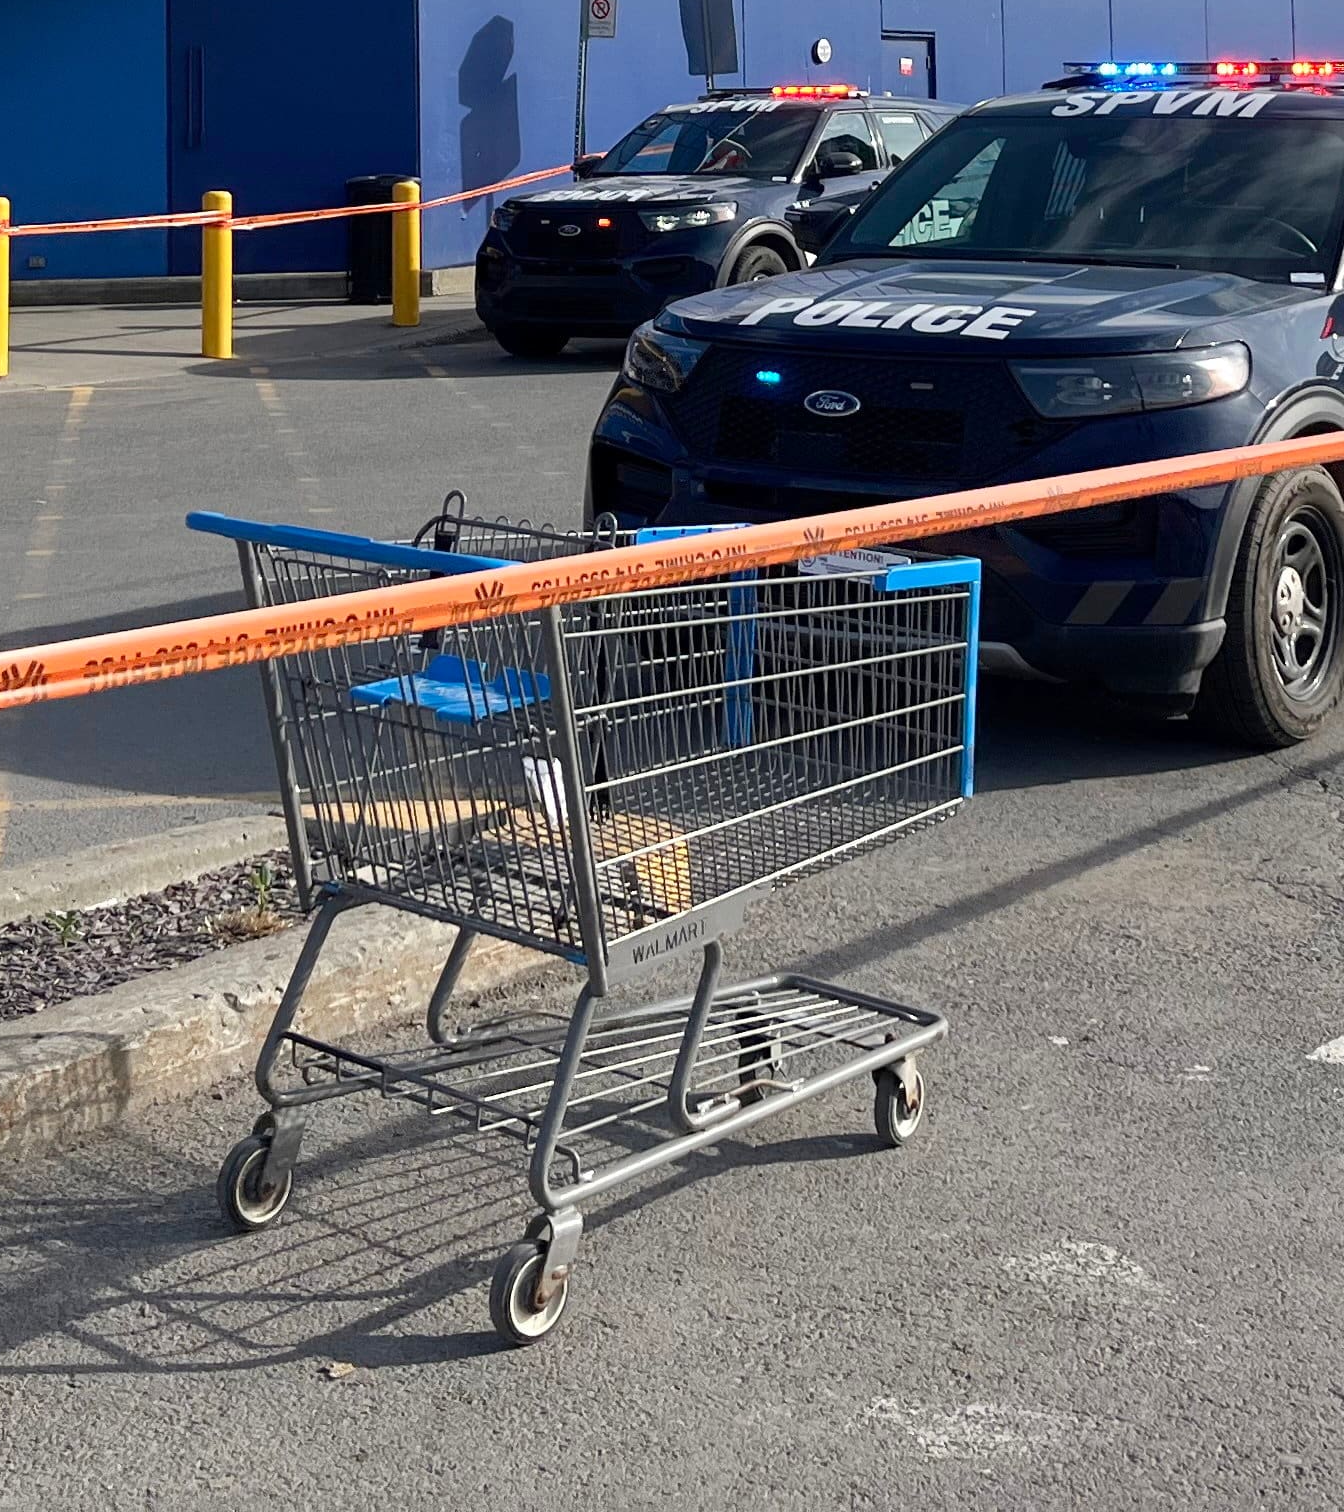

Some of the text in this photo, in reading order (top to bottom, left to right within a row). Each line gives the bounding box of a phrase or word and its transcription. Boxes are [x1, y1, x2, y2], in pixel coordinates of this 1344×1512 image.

[1050, 91, 1277, 118] SPVM
[738, 298, 1037, 340] POLICE
[816, 394, 847, 411] Ford
[631, 918, 708, 965] WALMART
